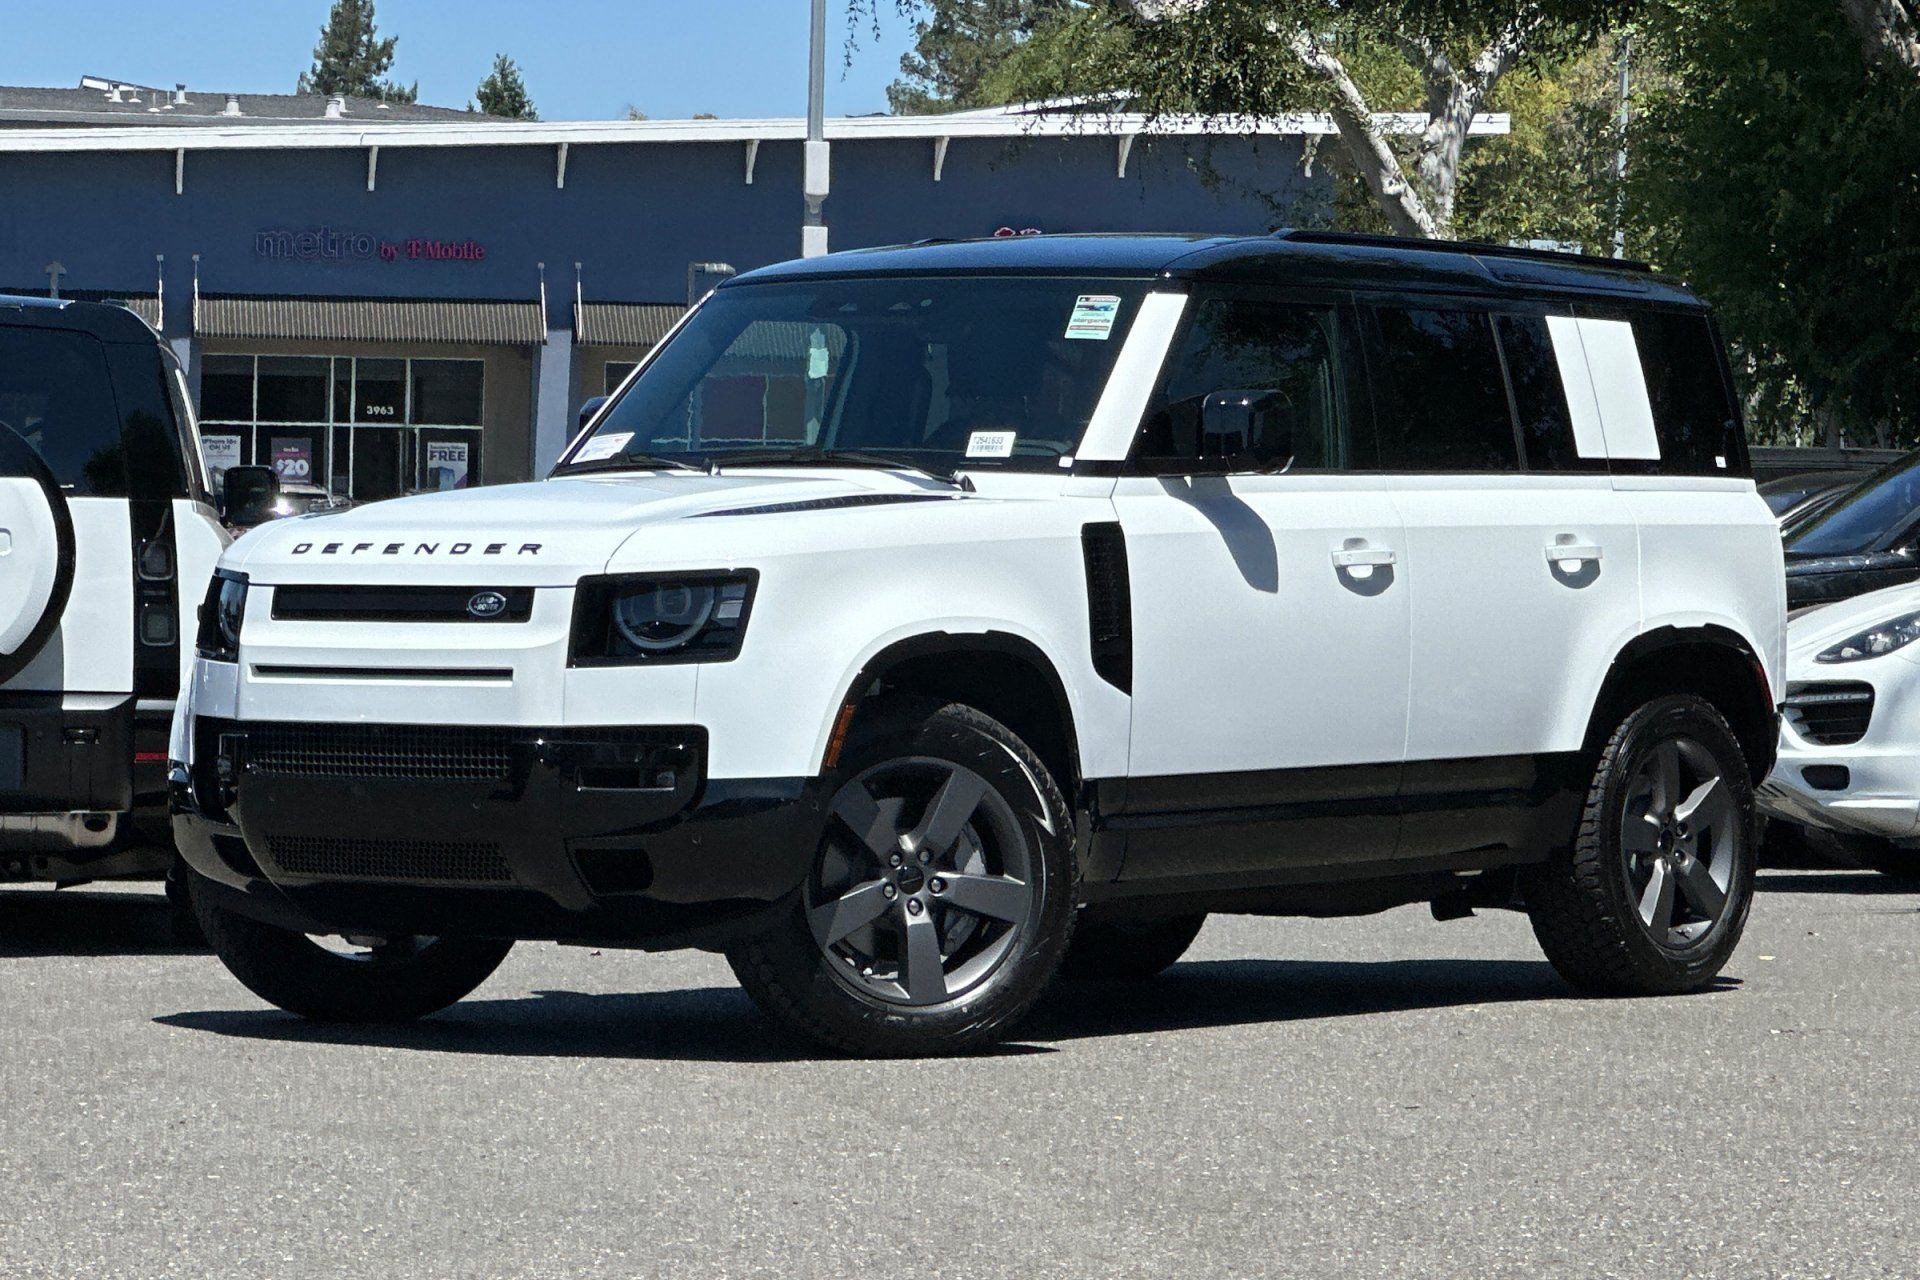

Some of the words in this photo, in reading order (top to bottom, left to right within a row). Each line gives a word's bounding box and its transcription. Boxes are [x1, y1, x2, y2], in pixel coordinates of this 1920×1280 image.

[255, 226, 377, 259] metro
[380, 241, 398, 262] by
[366, 405, 394, 415] 3963
[429, 450, 466, 462] FREE
[276, 459, 310, 477] $20
[291, 542, 543, 555] DEFENDER
